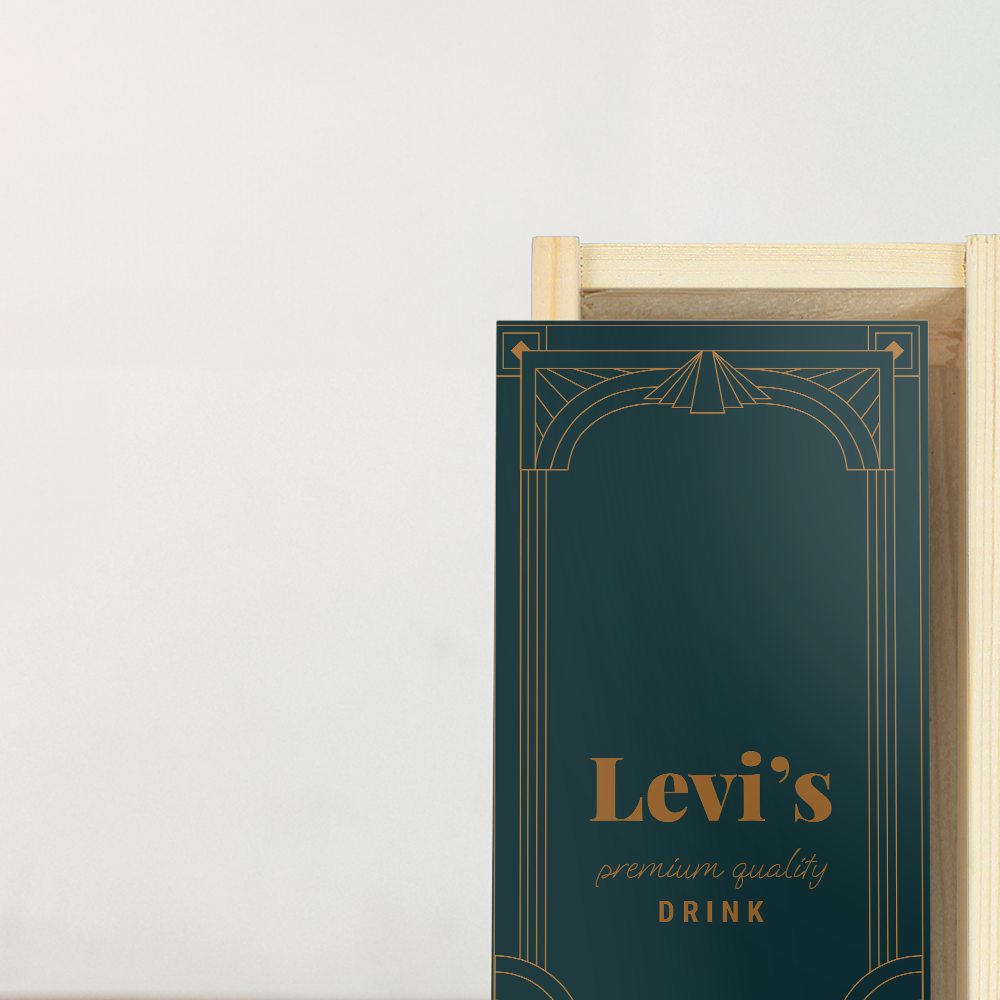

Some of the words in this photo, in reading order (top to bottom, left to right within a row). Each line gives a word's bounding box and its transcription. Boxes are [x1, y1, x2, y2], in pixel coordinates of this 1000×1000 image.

[590, 750, 833, 823] Levi’s
[595, 857, 725, 888] premium
[732, 847, 828, 889] quality
[659, 900, 764, 922] DRINK
